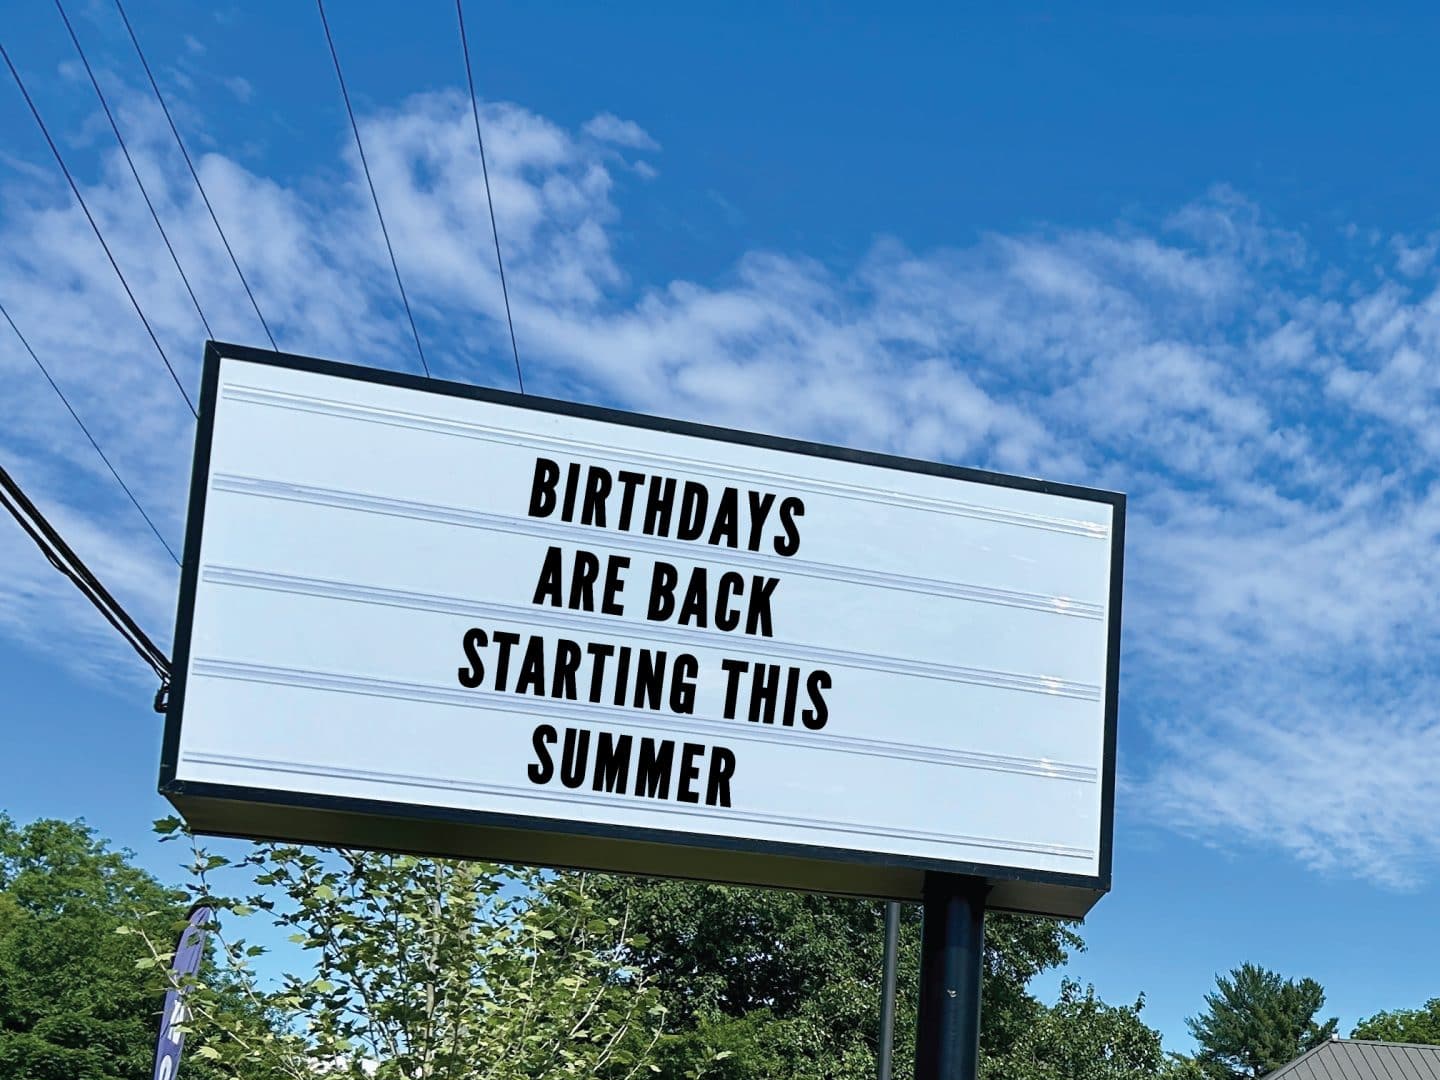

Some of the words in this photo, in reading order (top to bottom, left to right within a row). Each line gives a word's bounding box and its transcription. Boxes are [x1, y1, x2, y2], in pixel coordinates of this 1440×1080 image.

[528, 457, 806, 557] BIRTHDAYS
[532, 546, 631, 617] ARE
[647, 561, 780, 638] BACK
[458, 627, 699, 715] STARTING
[722, 658, 832, 731] THIS
[527, 724, 736, 808] SUMMER
